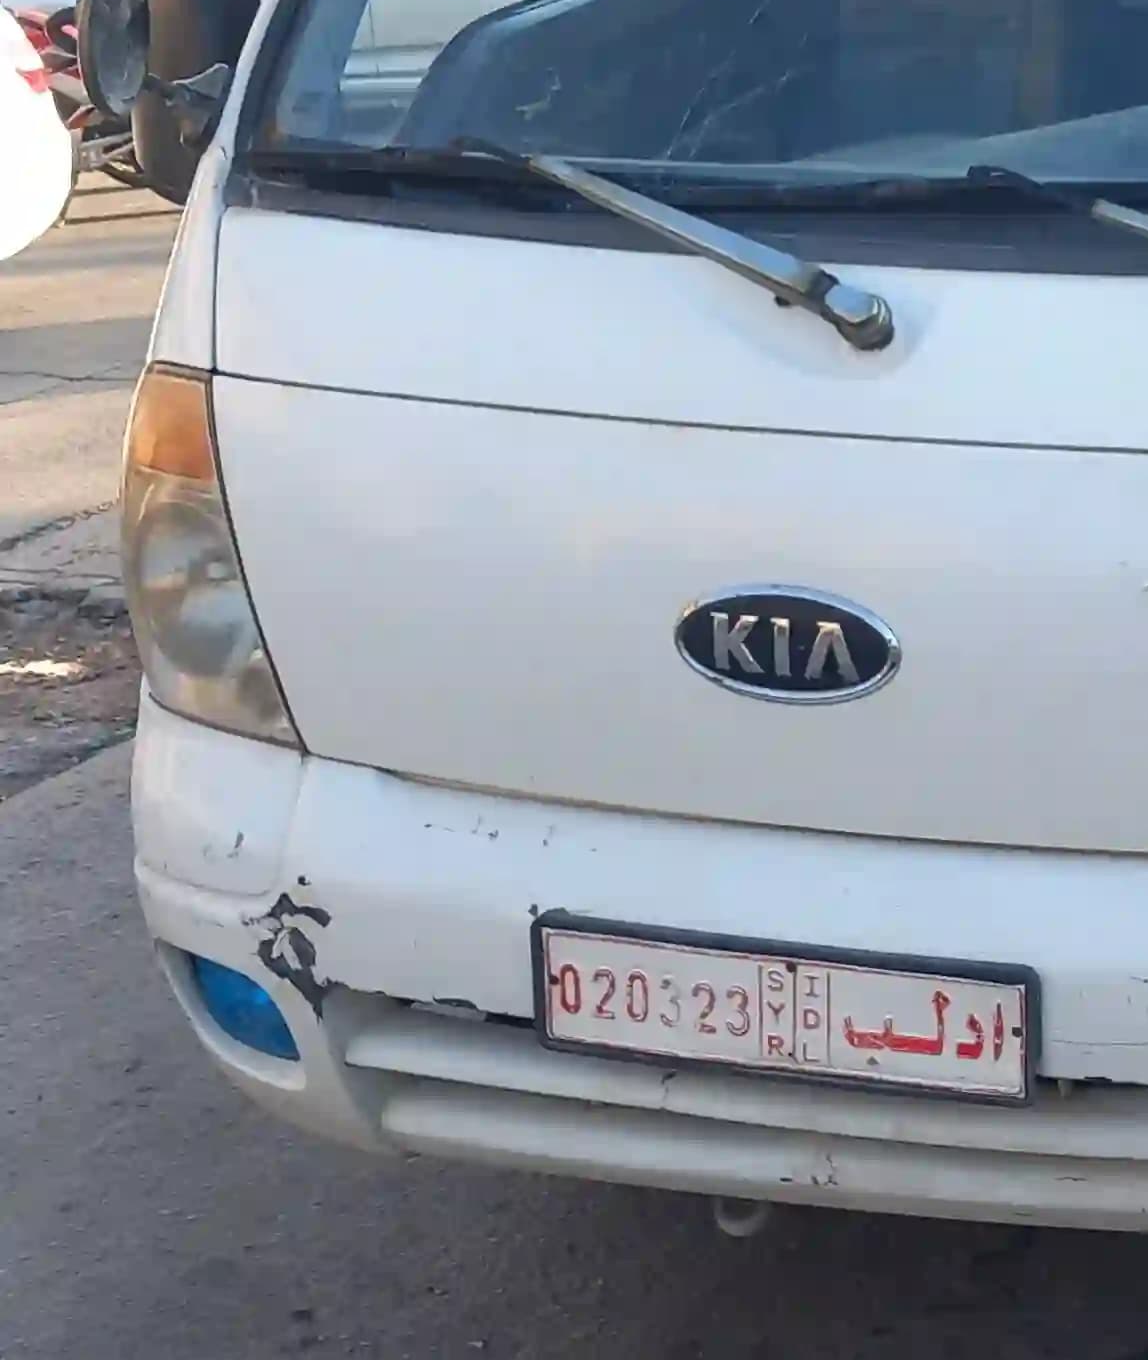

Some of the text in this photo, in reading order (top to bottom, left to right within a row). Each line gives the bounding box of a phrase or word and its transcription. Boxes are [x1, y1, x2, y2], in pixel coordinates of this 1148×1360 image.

[710, 611, 860, 683] KIA
[559, 962, 750, 1037] 020323
[766, 967, 786, 1057] SYR
[802, 974, 821, 1063] IDL
